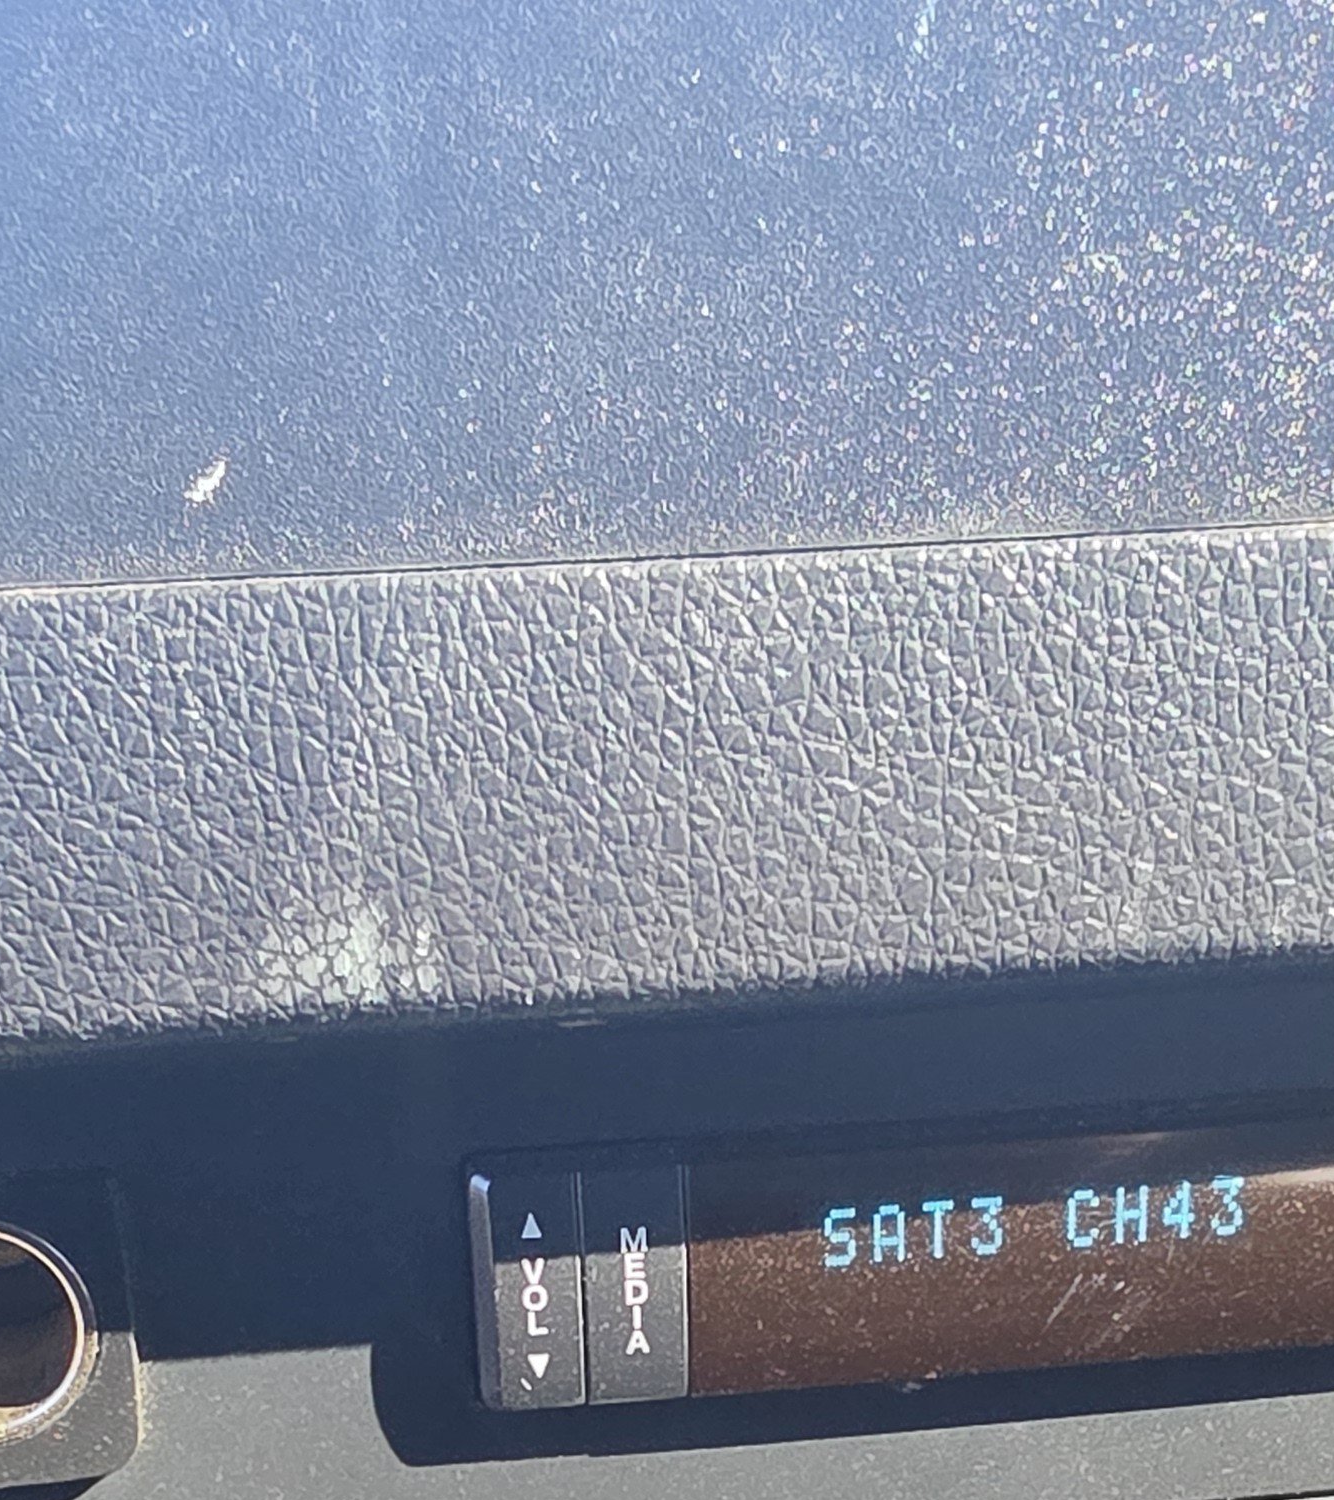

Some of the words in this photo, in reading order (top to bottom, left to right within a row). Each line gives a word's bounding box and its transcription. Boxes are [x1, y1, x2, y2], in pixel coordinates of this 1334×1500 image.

[824, 1196, 1003, 1268] SAT3
[1067, 1175, 1245, 1248] CH43
[521, 1257, 549, 1336] VOL
[620, 1226, 650, 1355] MEDIA
